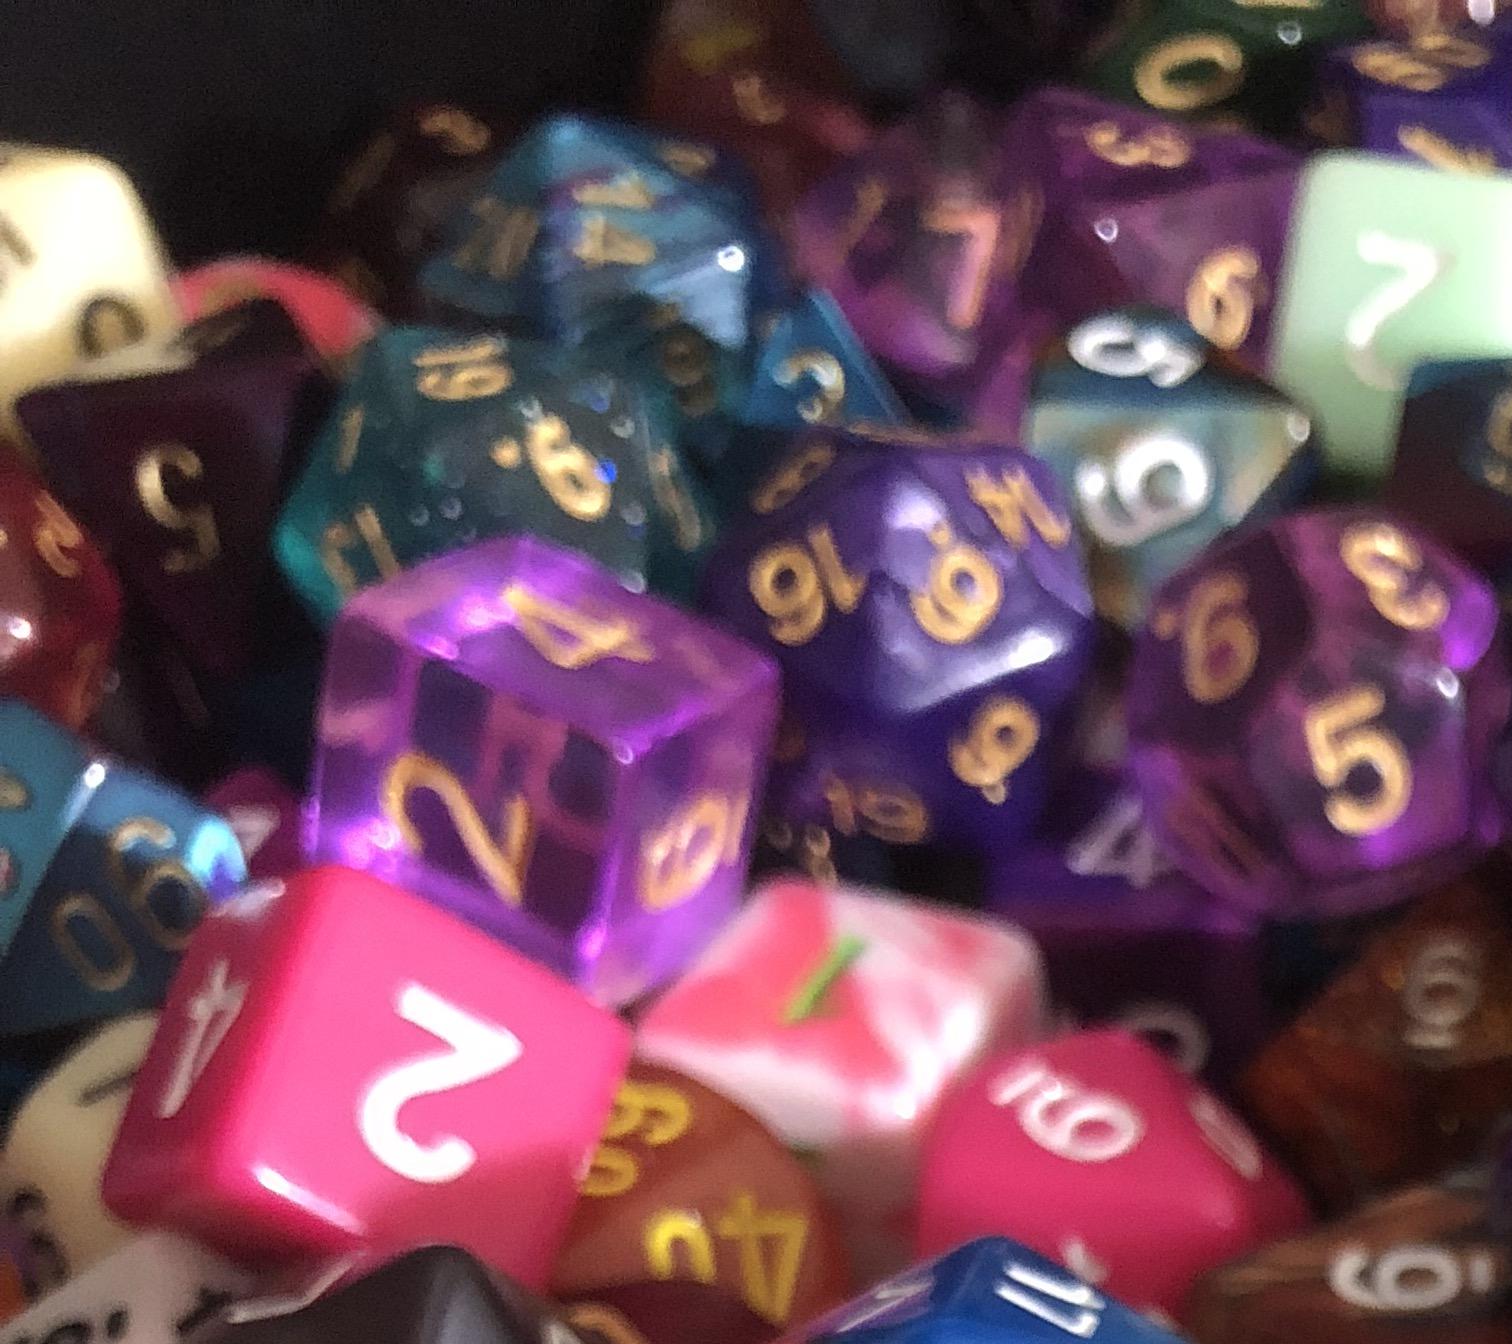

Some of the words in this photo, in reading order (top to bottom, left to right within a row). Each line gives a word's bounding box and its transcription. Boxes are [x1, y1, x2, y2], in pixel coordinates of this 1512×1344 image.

[500, 583, 655, 668] 4
[380, 755, 535, 905] 2
[1303, 683, 1412, 835] 5
[160, 958, 250, 1118] 4
[357, 980, 523, 1183] 2
[718, 1193, 805, 1322] 4
